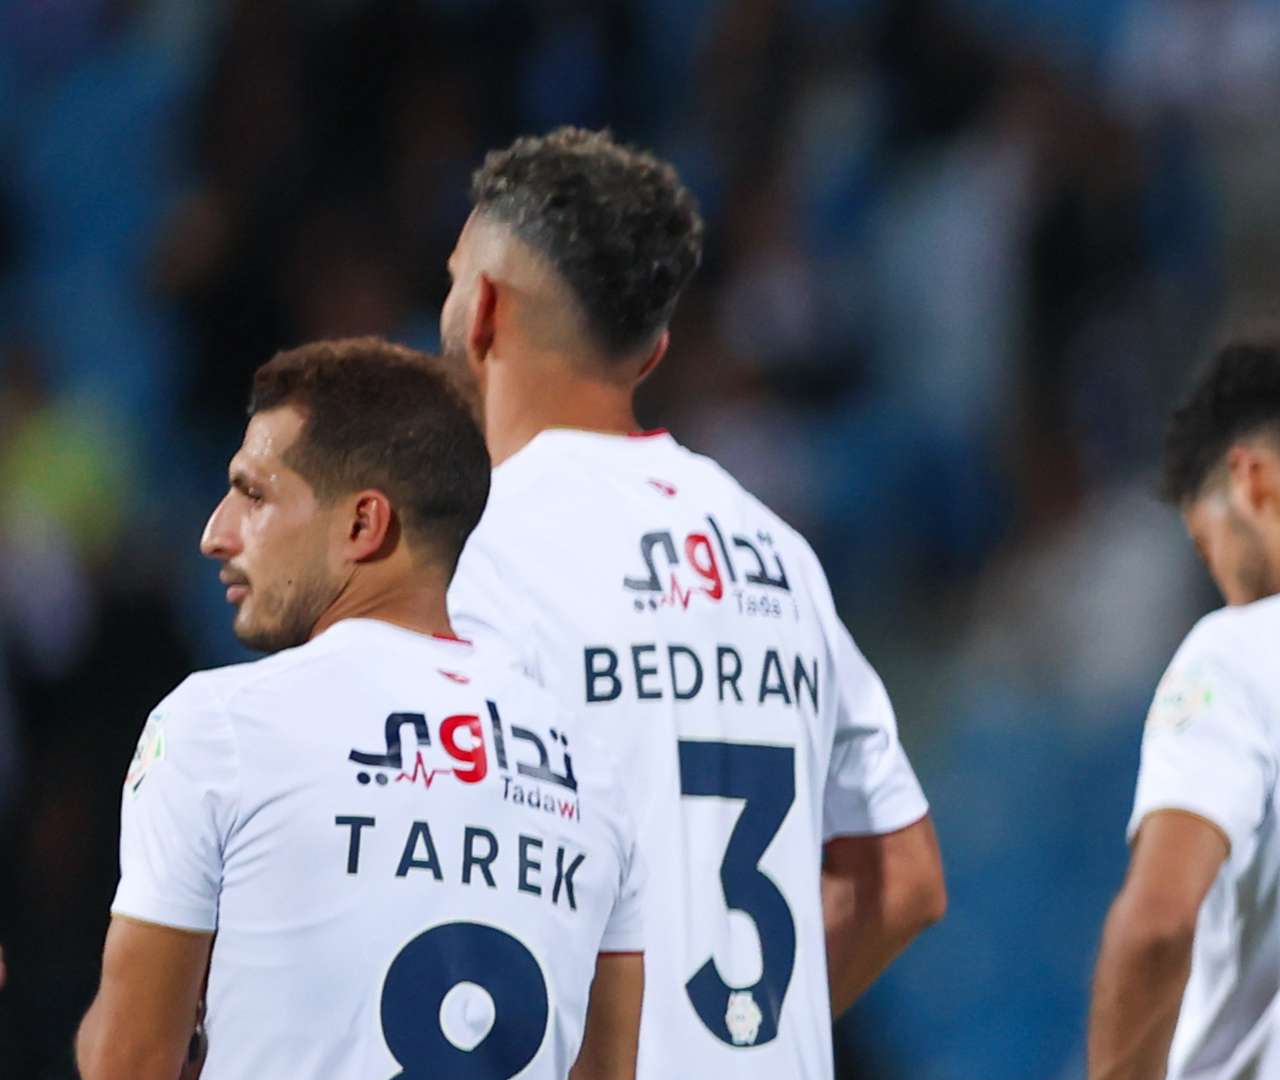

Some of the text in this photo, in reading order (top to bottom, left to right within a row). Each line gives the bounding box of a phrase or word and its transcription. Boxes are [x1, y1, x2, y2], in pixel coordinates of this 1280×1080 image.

[584, 644, 818, 715] BEDRAN
[334, 815, 587, 911] TAREK
[677, 738, 798, 1047] 3
